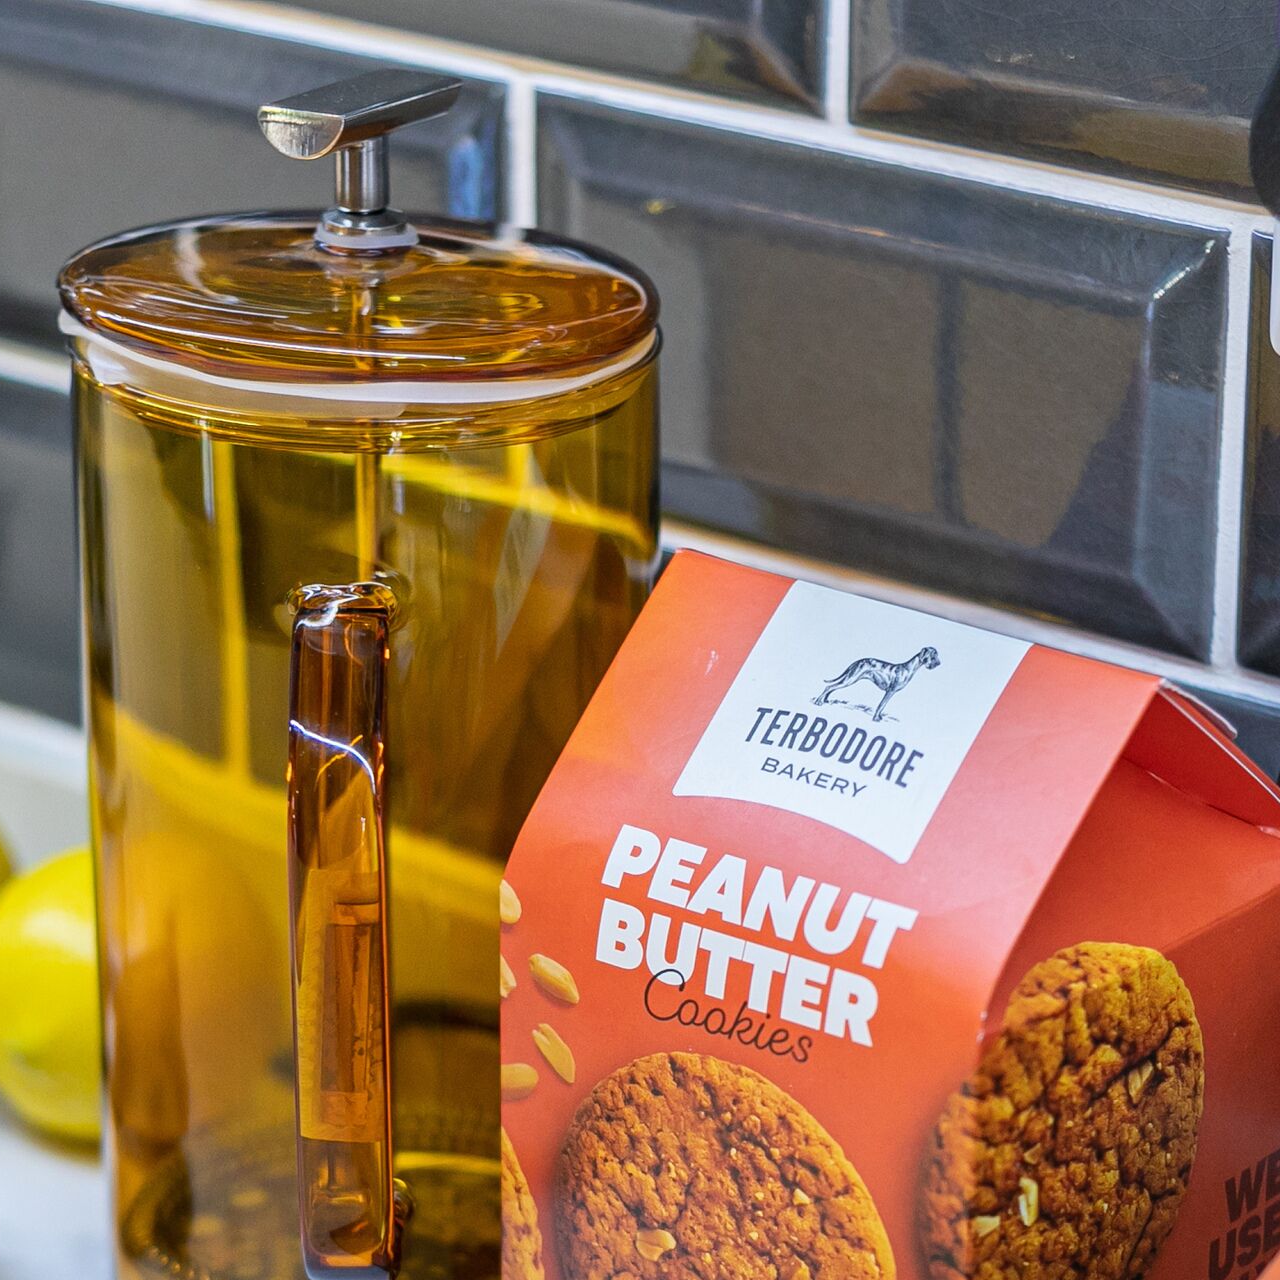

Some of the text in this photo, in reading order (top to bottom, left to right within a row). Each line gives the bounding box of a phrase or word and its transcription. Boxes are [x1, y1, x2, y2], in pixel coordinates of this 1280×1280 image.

[745, 707, 924, 788] TERBODORE
[761, 757, 867, 798] BAKERY
[601, 824, 919, 969] PEANUT
[596, 898, 879, 1048] BUTTER
[644, 969, 813, 1062] Cookies
